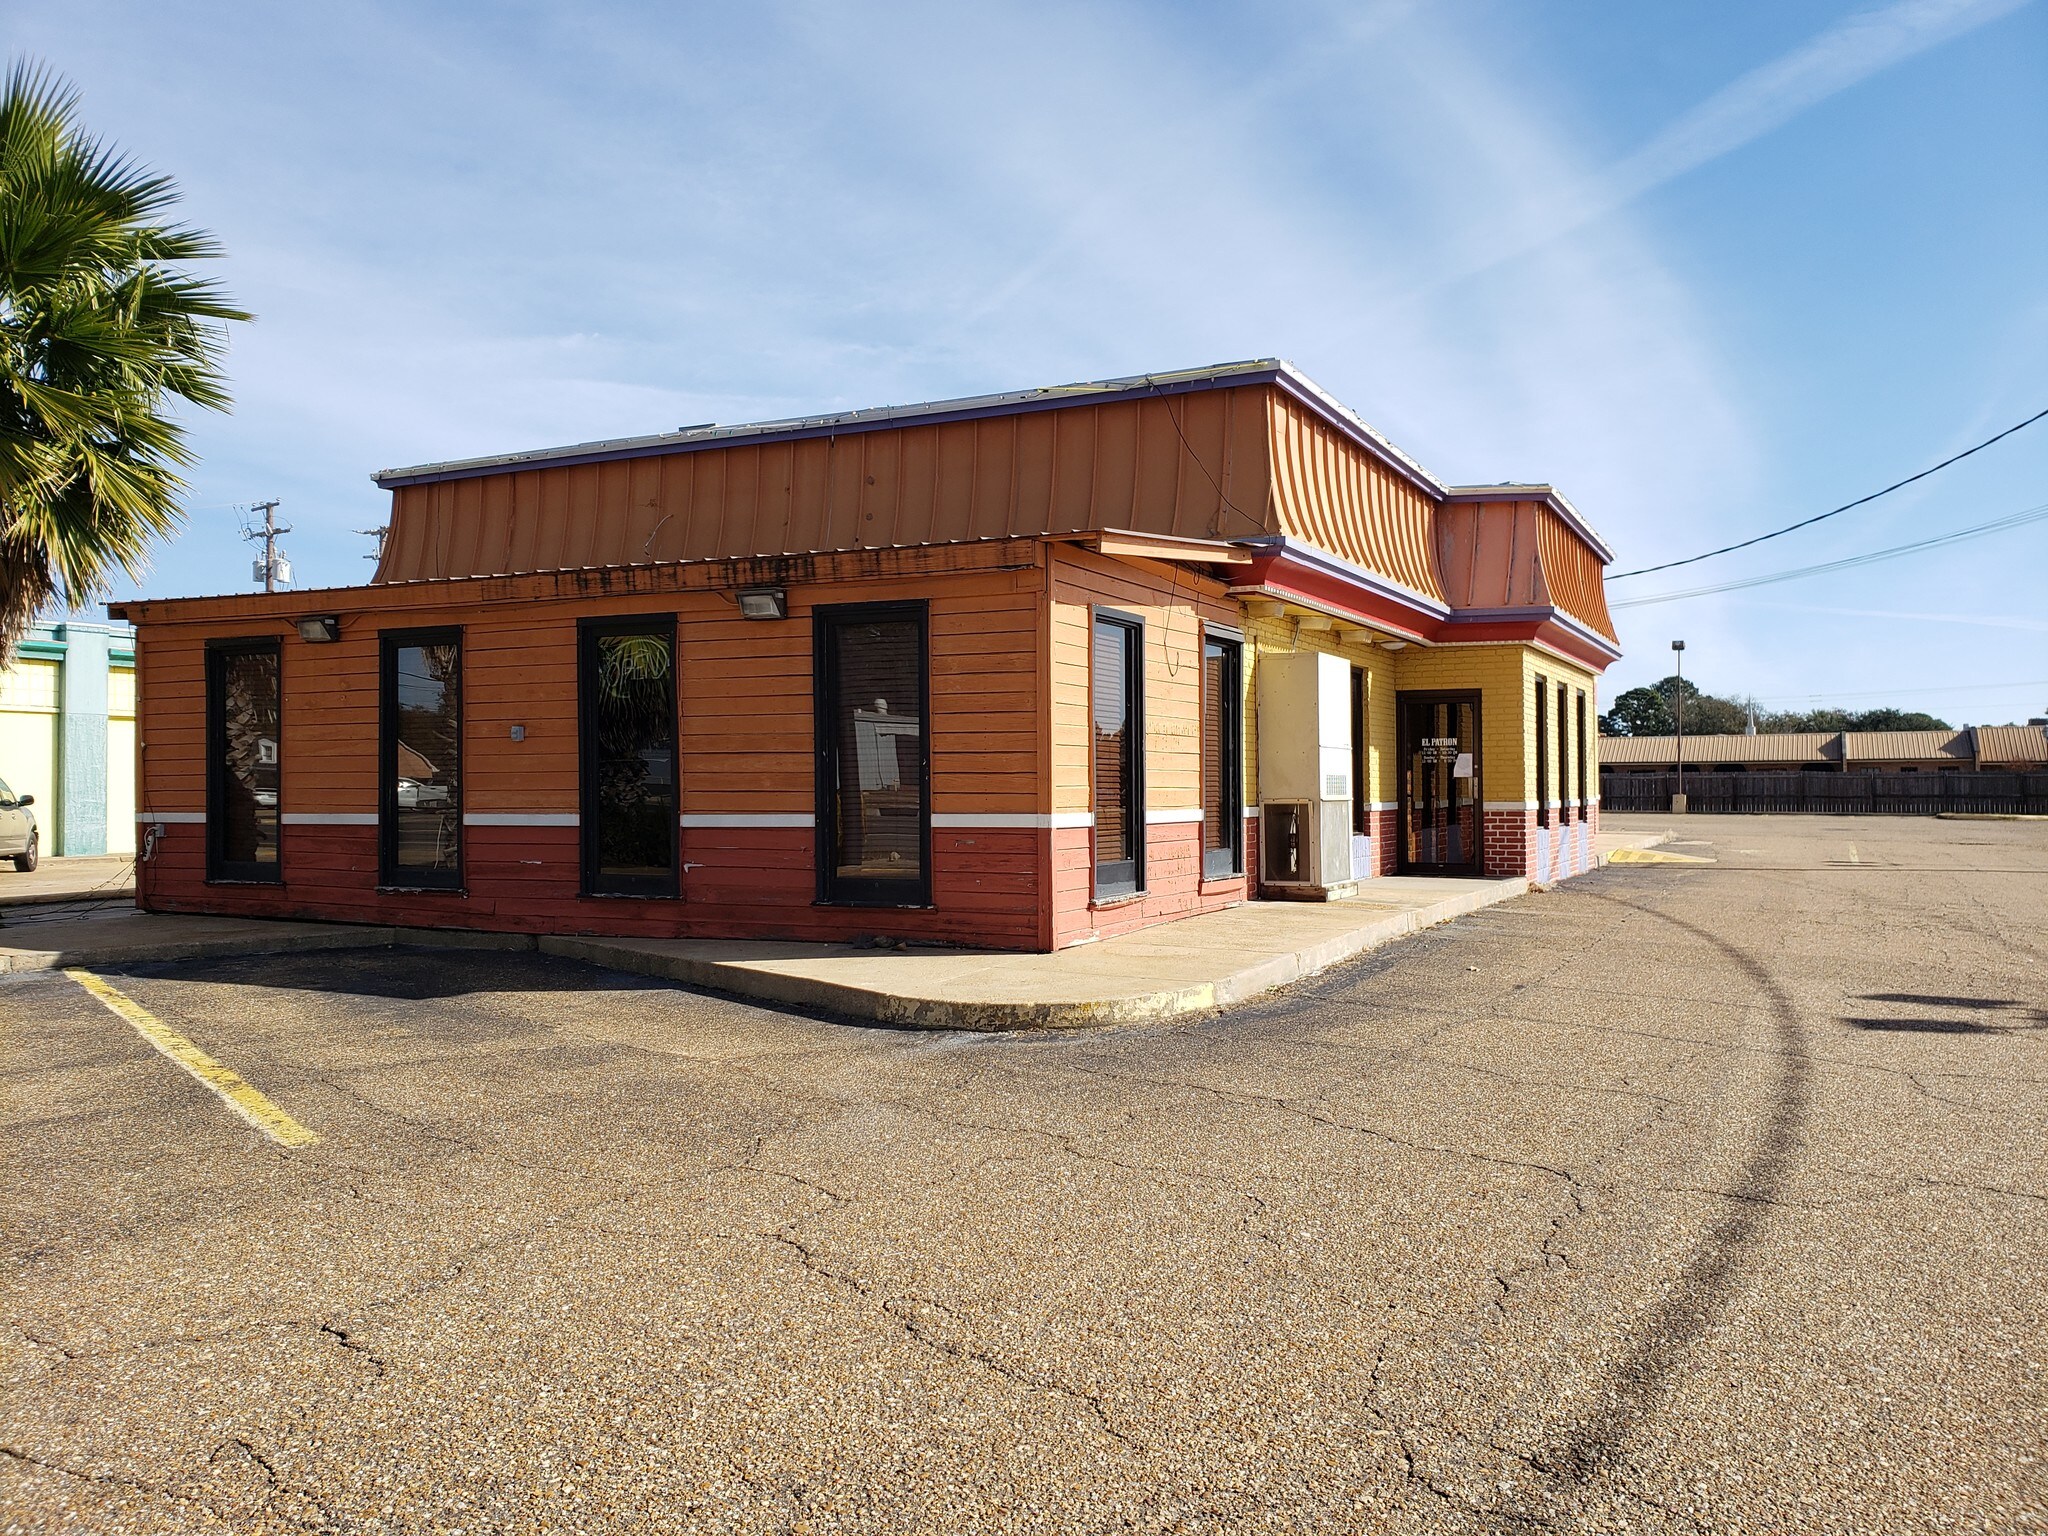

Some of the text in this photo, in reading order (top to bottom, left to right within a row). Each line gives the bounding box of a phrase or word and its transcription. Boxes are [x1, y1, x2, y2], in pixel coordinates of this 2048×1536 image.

[606, 649, 659, 699] OPEN
[1421, 738, 1457, 746] EL PATRON
